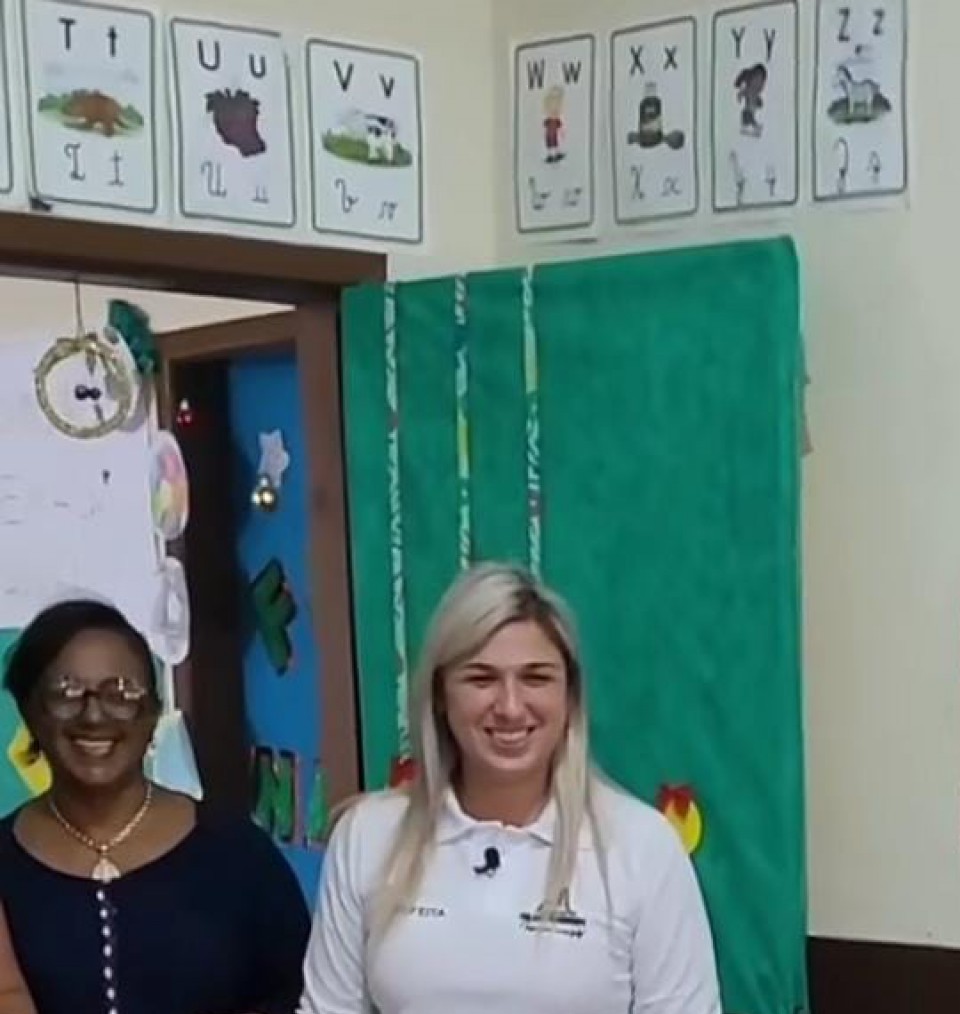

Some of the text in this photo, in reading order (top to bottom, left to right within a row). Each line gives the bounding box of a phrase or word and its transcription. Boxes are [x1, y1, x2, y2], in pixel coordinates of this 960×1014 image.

[58, 17, 118, 58] T t
[837, 7, 885, 42] Z z
[197, 39, 267, 79] U u
[630, 45, 678, 76] X x
[731, 27, 776, 62] Y y
[333, 60, 395, 99] V v
[527, 59, 582, 90] W w
